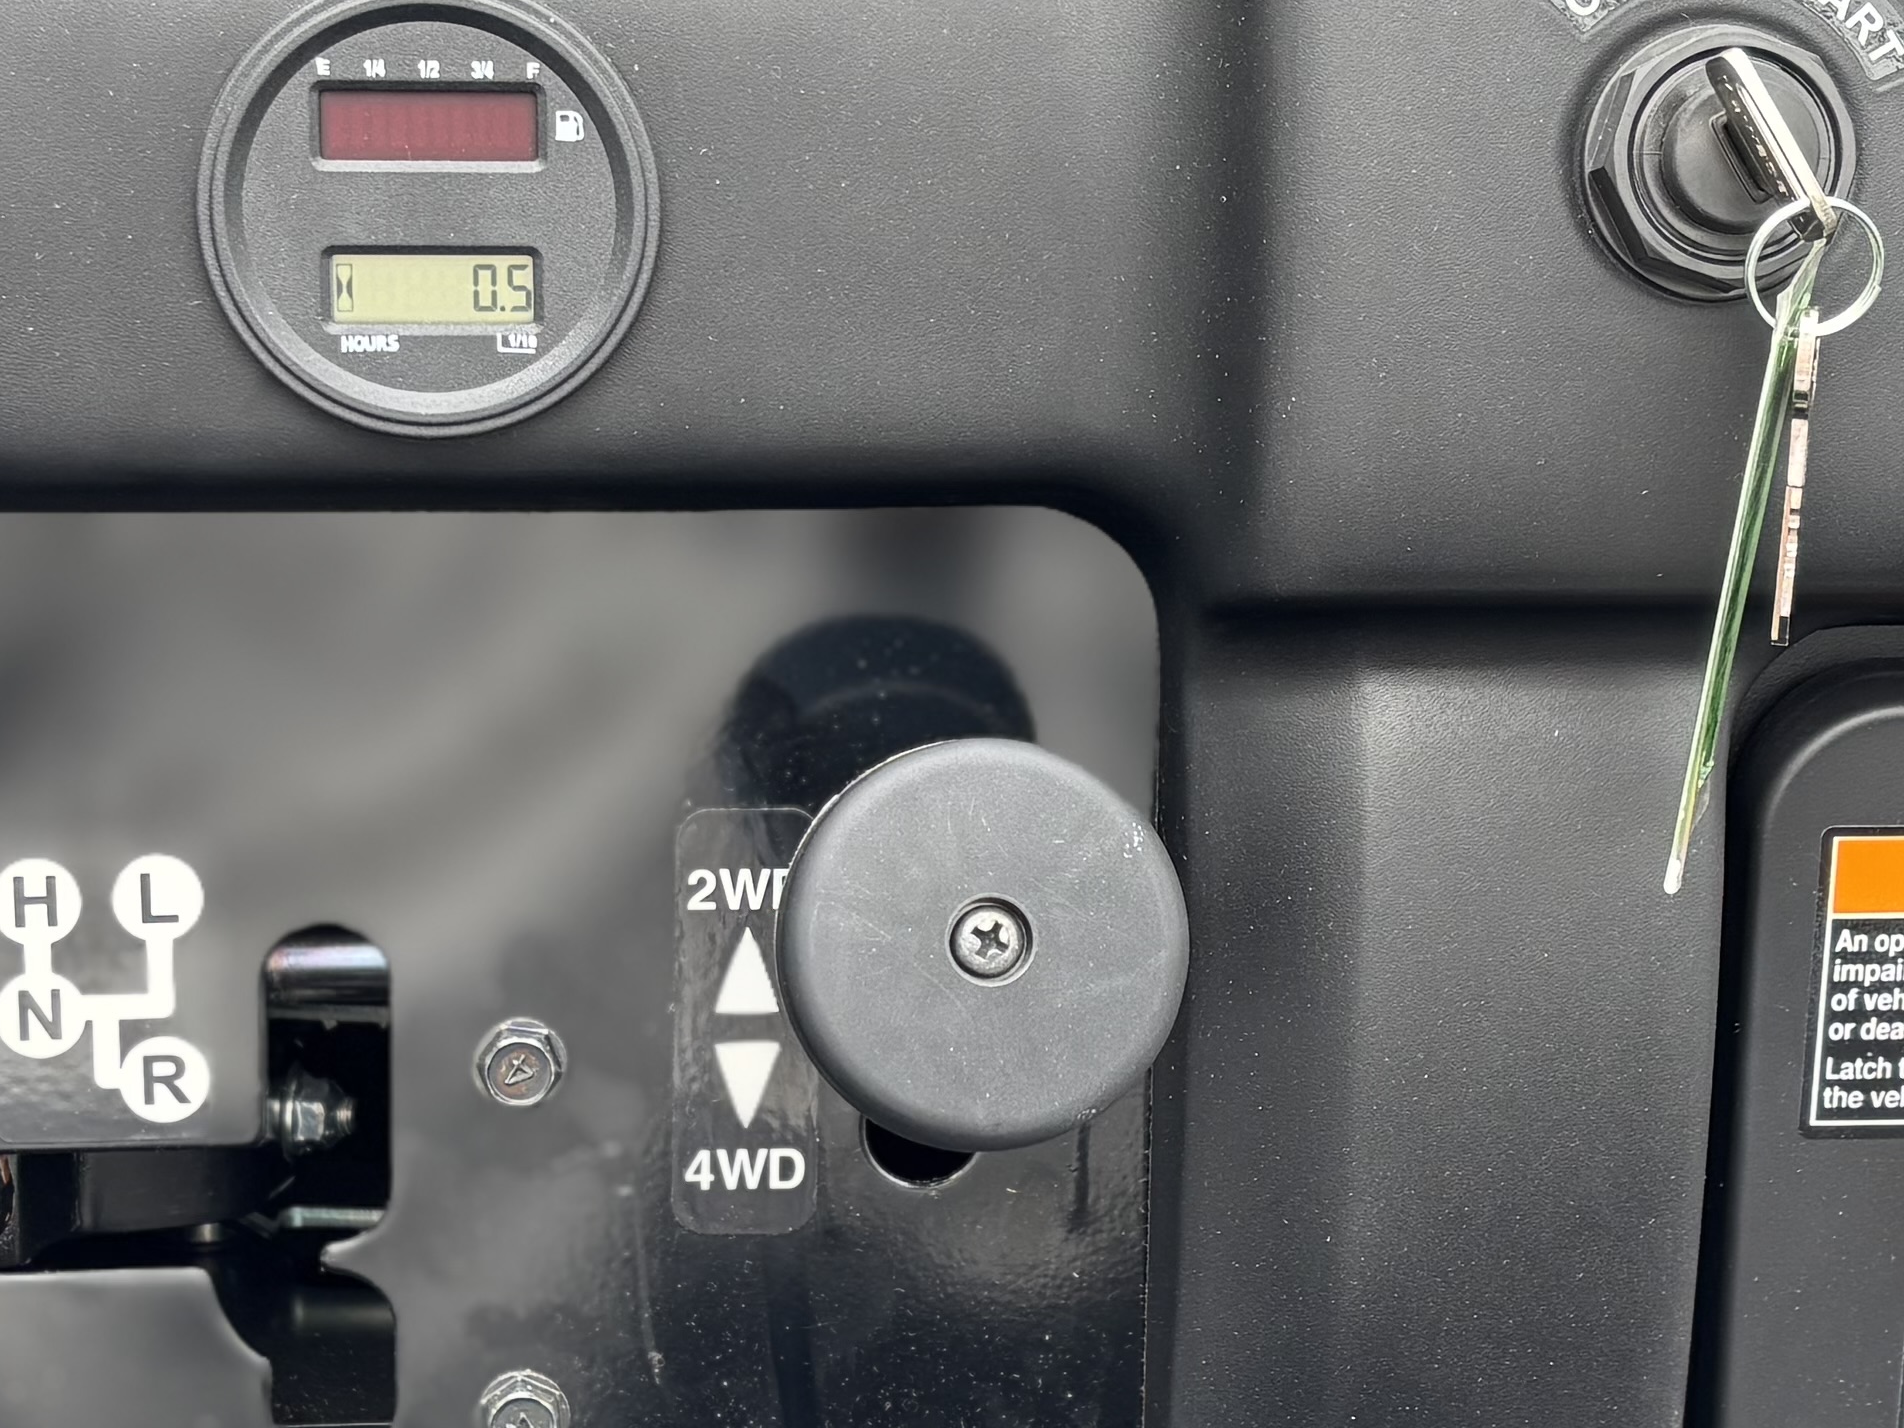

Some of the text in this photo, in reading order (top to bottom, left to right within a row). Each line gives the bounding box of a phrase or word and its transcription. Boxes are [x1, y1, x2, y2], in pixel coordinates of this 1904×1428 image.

[315, 57, 541, 81] E 1/4 1/2 3/4 F
[472, 263, 533, 313] 0.5
[340, 334, 400, 353] HOURS
[12, 875, 57, 927] H
[139, 873, 178, 923] L
[1834, 928, 1868, 952] An
[1830, 987, 1859, 1011] of
[17, 988, 61, 1041] N
[1828, 1022, 1856, 1040] or
[142, 1054, 190, 1105] R
[1825, 1052, 1892, 1080] Latch
[1822, 1085, 1864, 1108] the
[684, 1147, 805, 1190] 4WD
